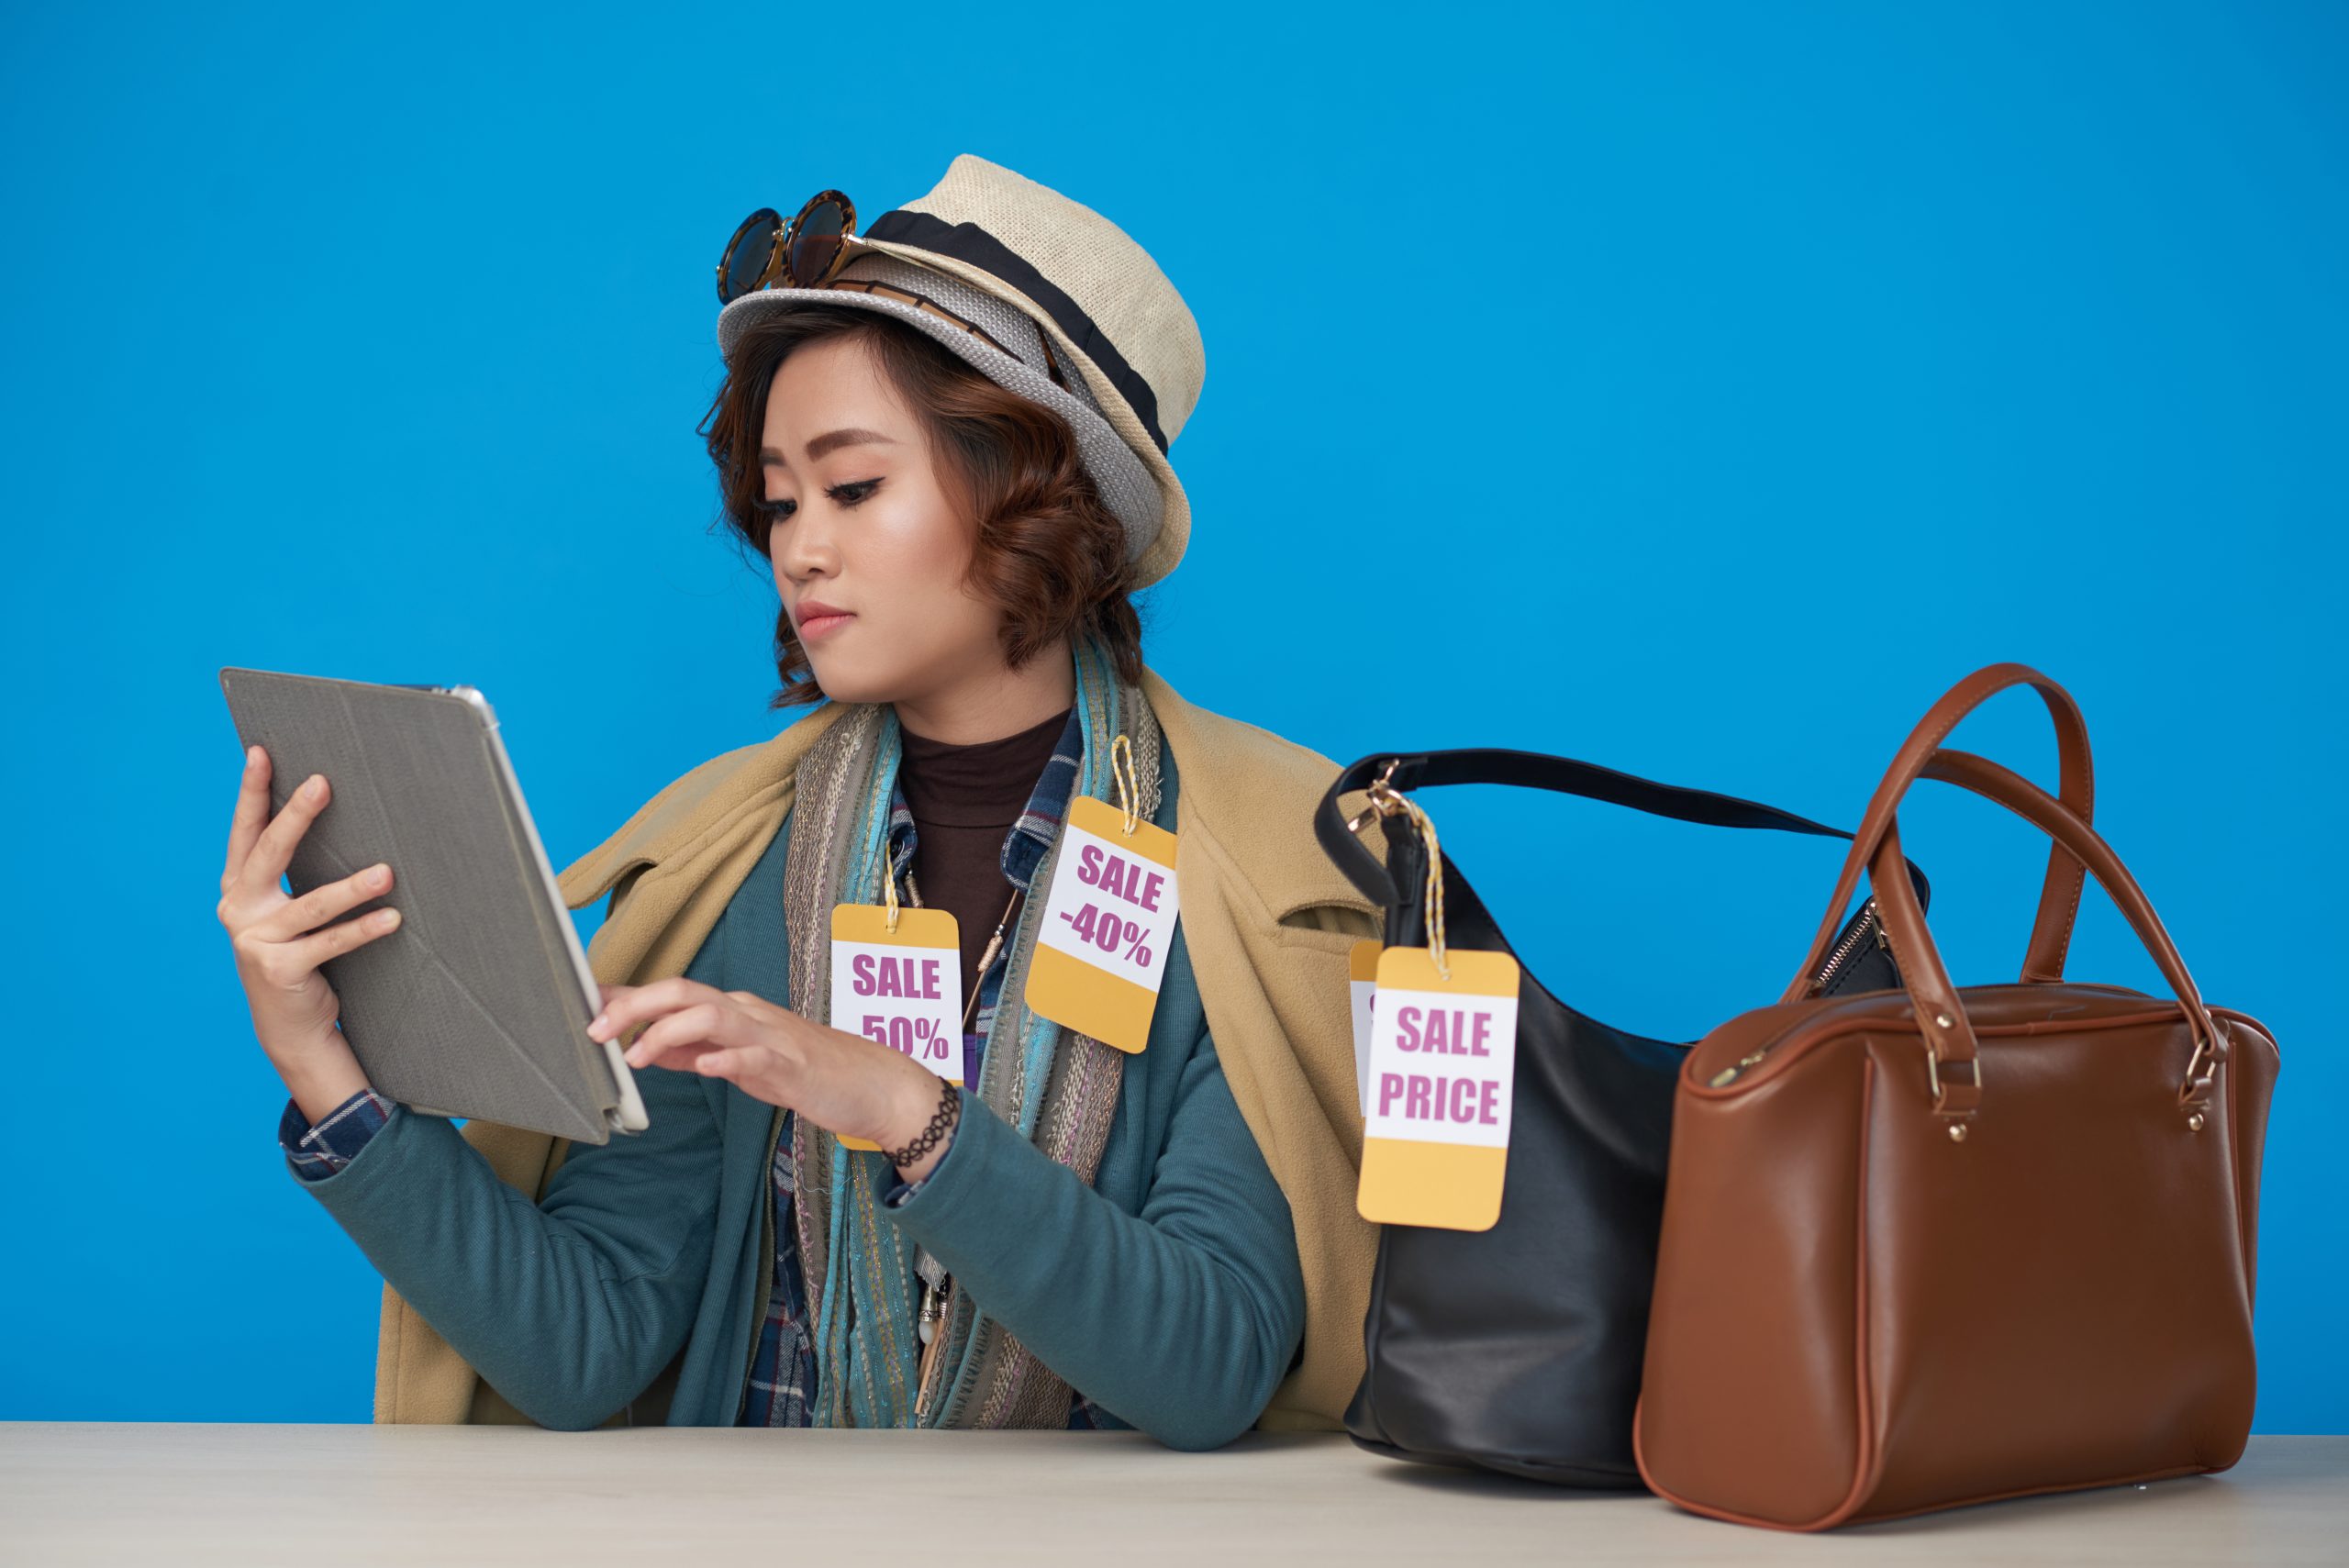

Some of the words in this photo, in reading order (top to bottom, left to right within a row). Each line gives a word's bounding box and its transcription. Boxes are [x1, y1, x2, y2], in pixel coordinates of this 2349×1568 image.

[1077, 844, 1165, 913] SALE
[1060, 903, 1152, 968] -40%
[852, 954, 941, 999] SALE
[1397, 1006, 1491, 1057] SALE
[1378, 1073, 1499, 1125] PRICE
